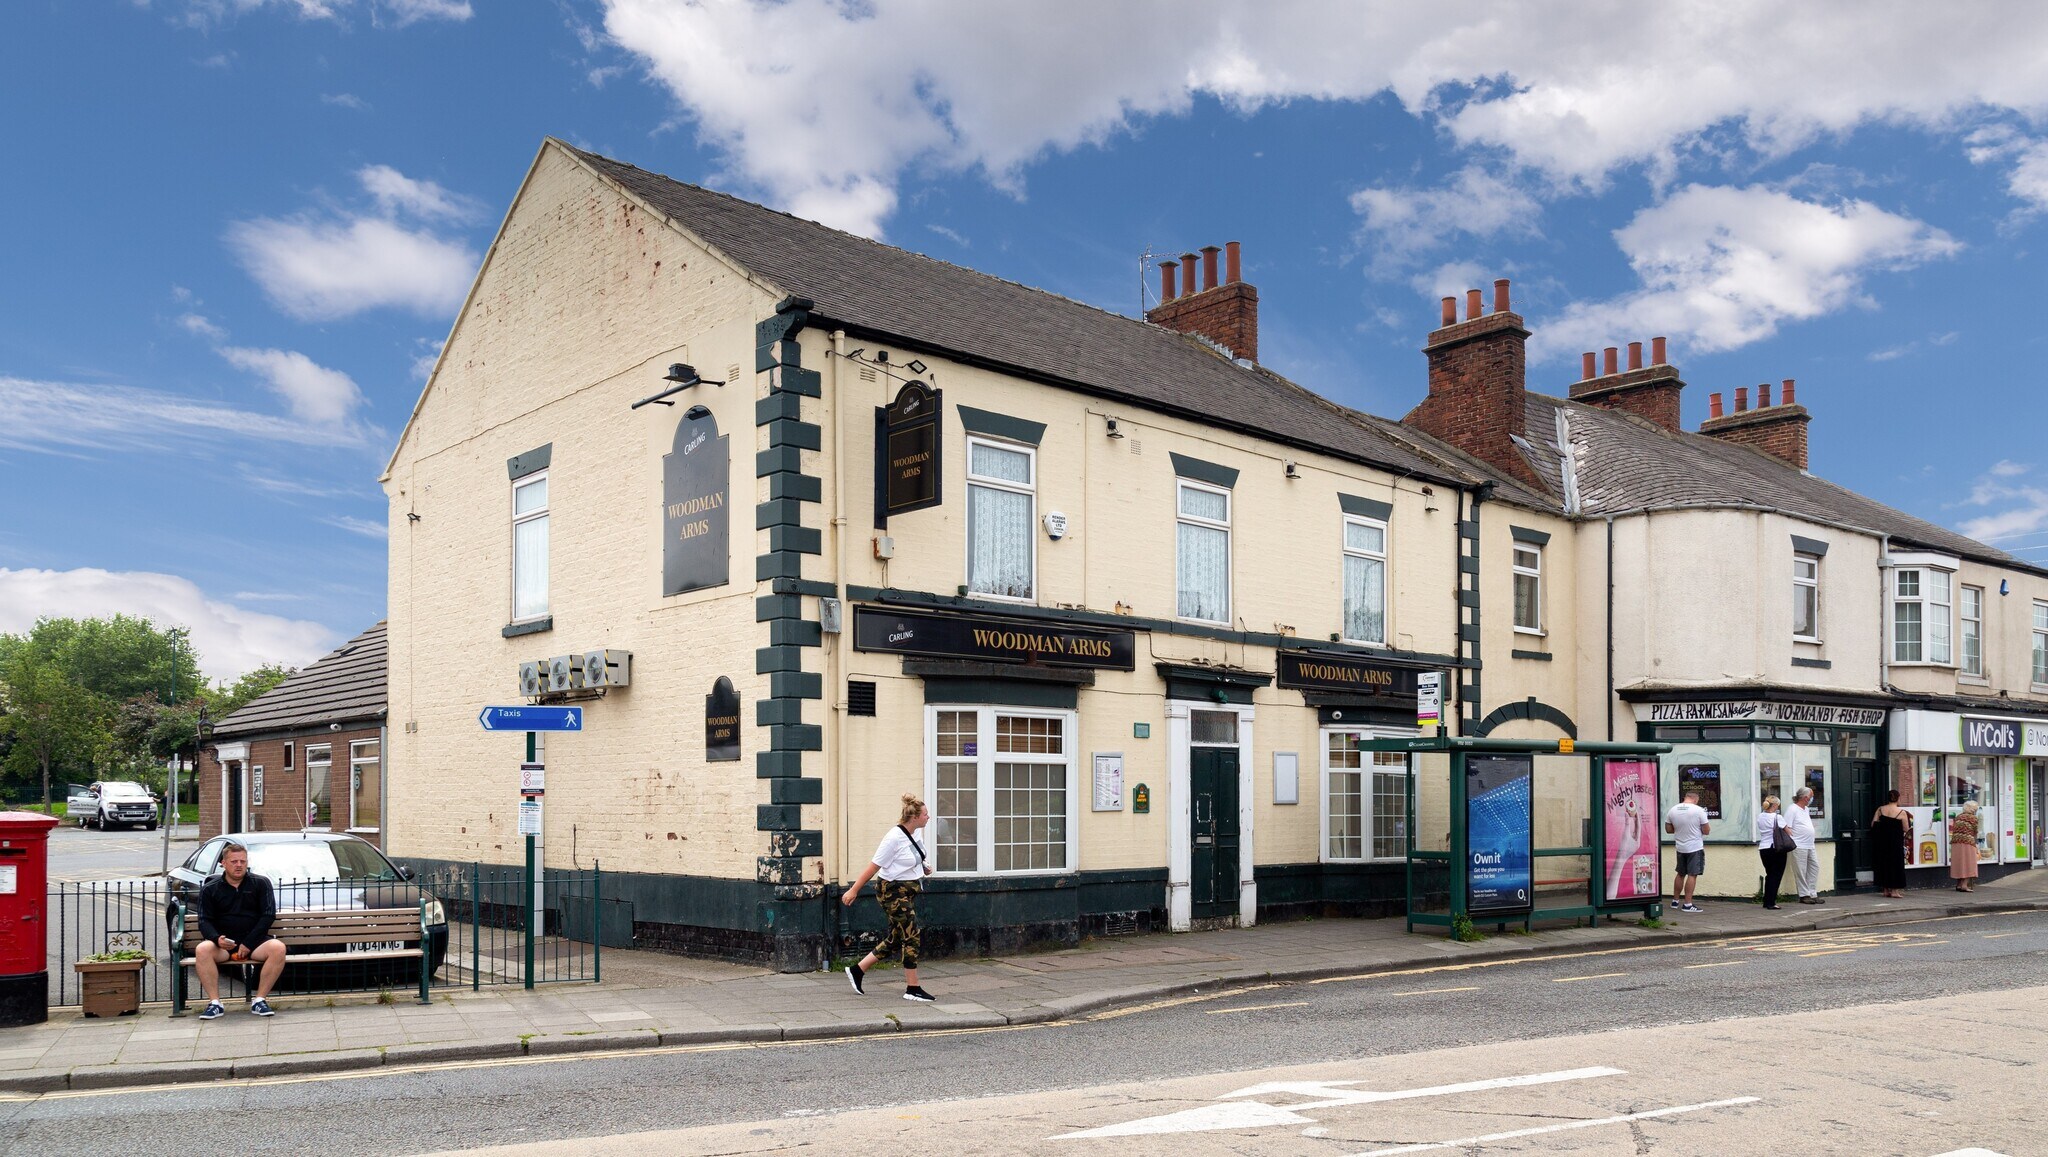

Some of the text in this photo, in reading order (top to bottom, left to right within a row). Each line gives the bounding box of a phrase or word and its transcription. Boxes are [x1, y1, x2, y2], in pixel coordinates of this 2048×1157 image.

[903, 400, 920, 415] CARLING
[684, 432, 705, 455] CARLING
[893, 451, 930, 468] WOODMAN
[902, 466, 921, 478] ARMS
[668, 492, 723, 519] WOODMAN
[680, 519, 709, 540] ARMS
[889, 630, 913, 643] CARLING
[973, 629, 1111, 657] WOODMAN ARMS
[1298, 663, 1392, 685] WOODMAN ARMS
[498, 709, 521, 717] Taxis
[708, 716, 738, 726] WOODMAN
[1776, 704, 1838, 722] NORMANBY
[1838, 709, 1860, 723] FISH
[1860, 710, 1883, 725] SHOP
[715, 729, 730, 738] ARMS
[1970, 722, 2014, 748] McColl's
[2027, 729, 2048, 746] @ No
[1607, 783, 1654, 814] Mighty taste.
[1474, 852, 1501, 865] Own it
